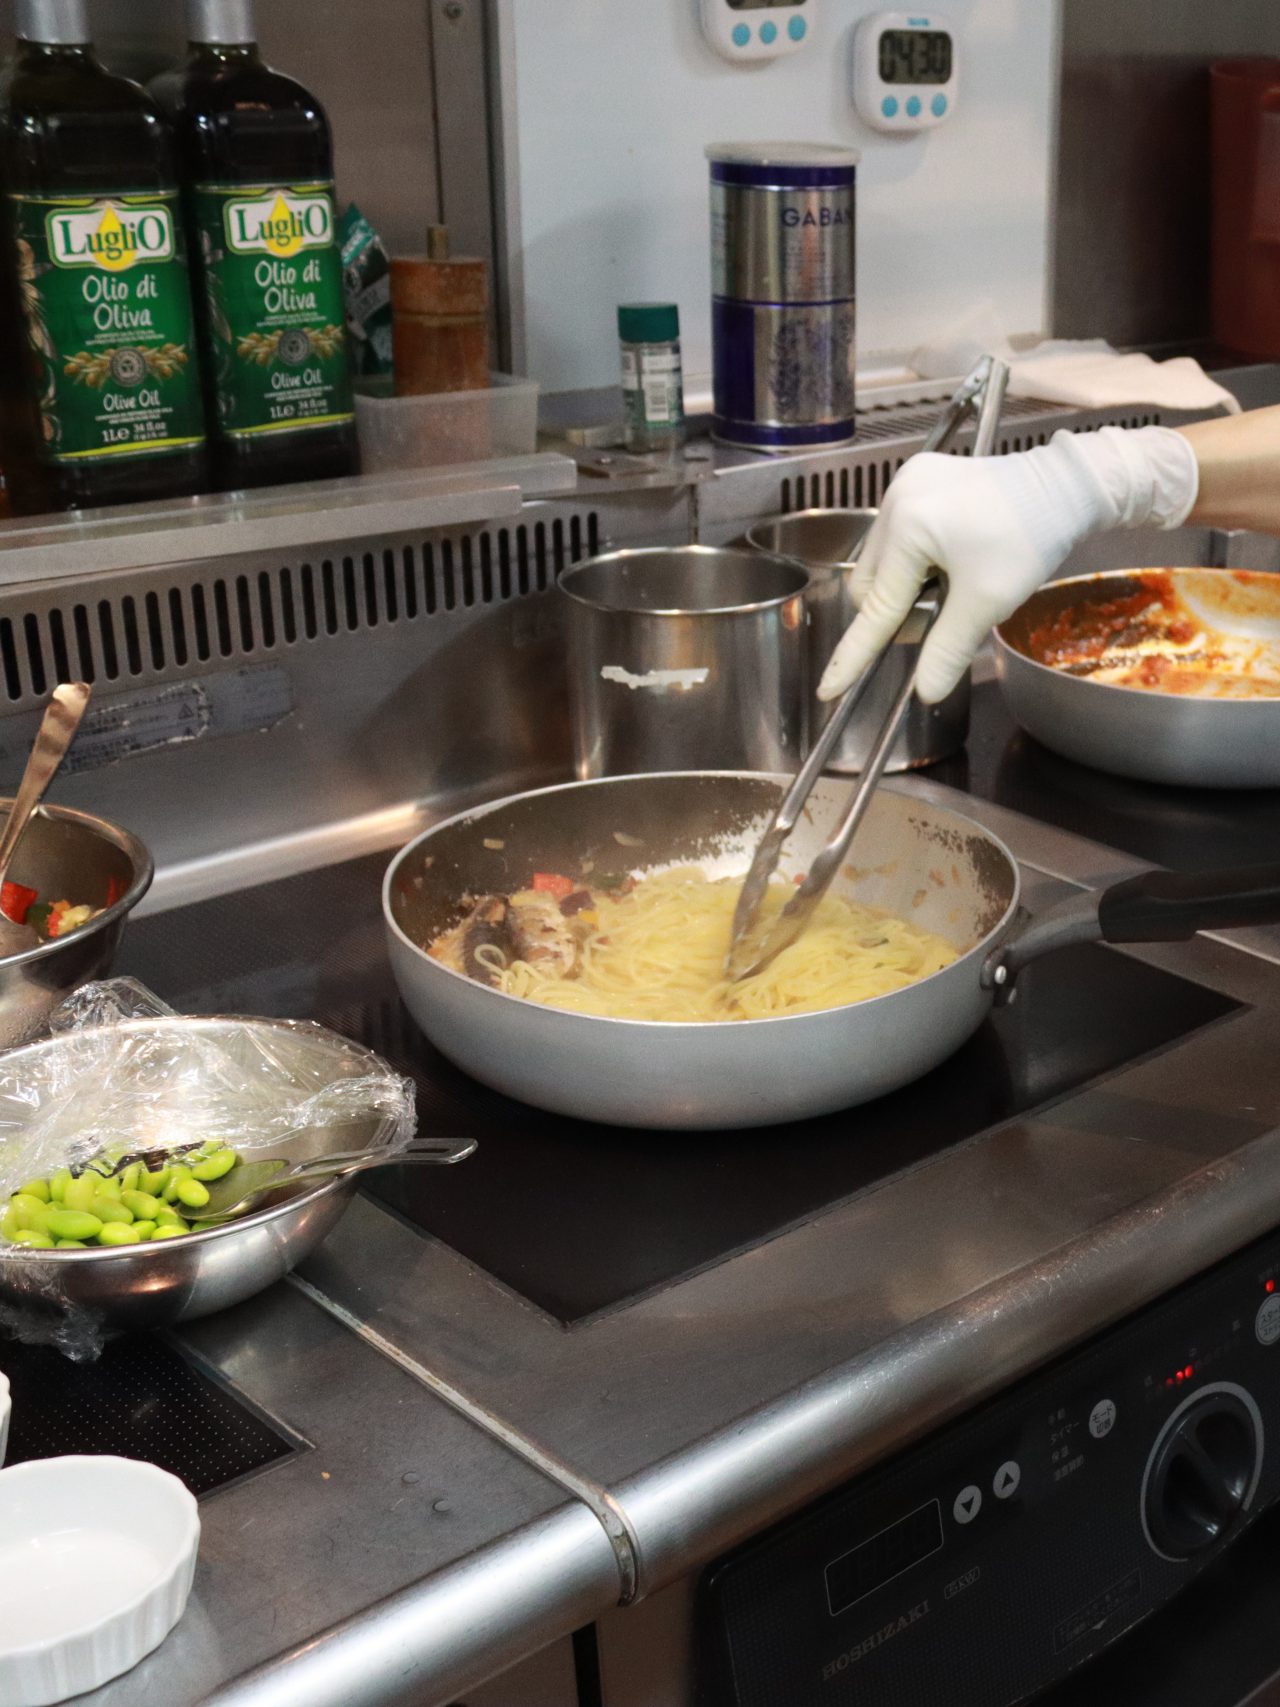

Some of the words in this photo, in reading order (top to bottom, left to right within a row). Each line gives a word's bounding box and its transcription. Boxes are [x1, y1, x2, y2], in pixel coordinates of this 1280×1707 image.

[255, 260, 297, 287] Olio
[302, 259, 321, 282] di
[82, 274, 129, 303] Olio
[136, 274, 158, 298] di
[264, 286, 316, 313] Oliva
[94, 303, 153, 330] Oliva
[271, 371, 300, 389] Olive
[303, 368, 322, 386] Oil
[103, 393, 136, 411] Olive
[139, 389, 160, 407] Oil
[821, 1598, 930, 1681] HOSHIZAKI
